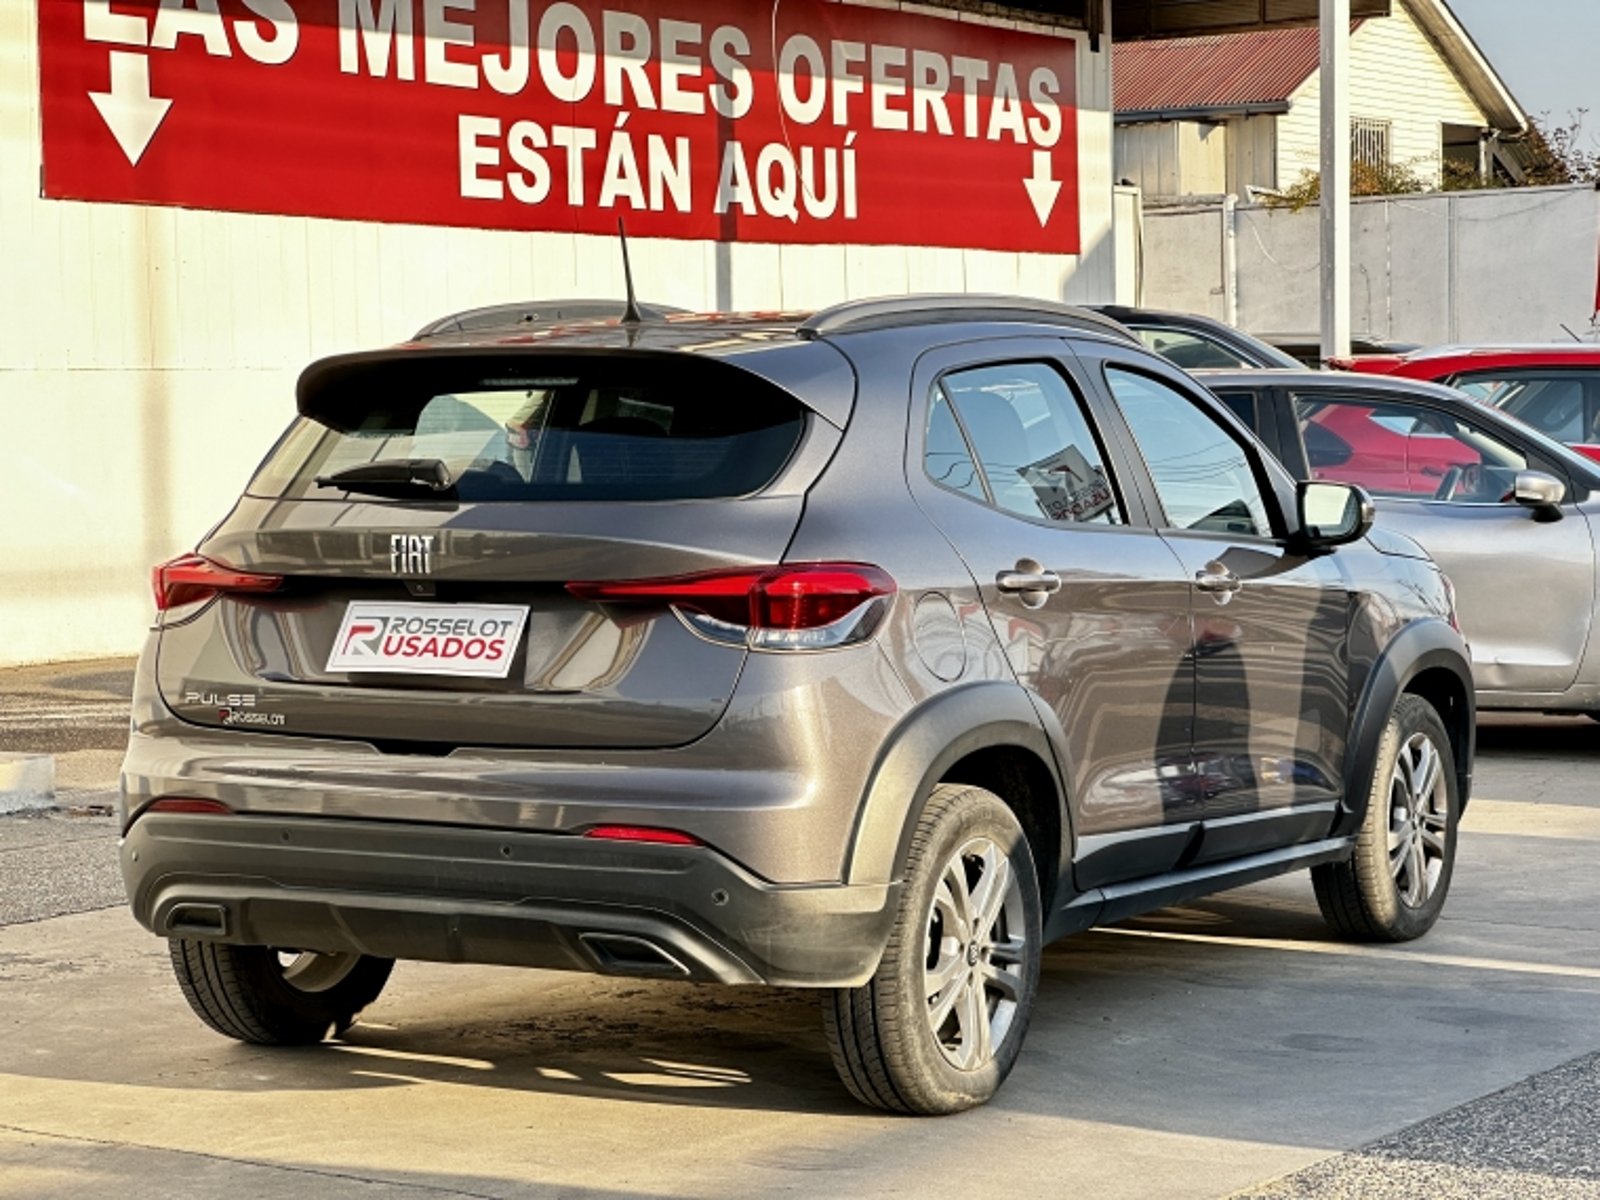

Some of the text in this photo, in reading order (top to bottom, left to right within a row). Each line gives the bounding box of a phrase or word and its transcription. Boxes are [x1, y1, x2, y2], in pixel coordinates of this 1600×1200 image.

[338, 0, 754, 119] MEJORES
[778, 34, 1063, 148] OFERTAS
[457, 111, 858, 223] ESTÁN AQUÍ
[390, 534, 434, 574] FIAT
[390, 616, 513, 637] ROSSELOT
[382, 635, 506, 660] USADOS
[184, 691, 256, 706] PULSE
